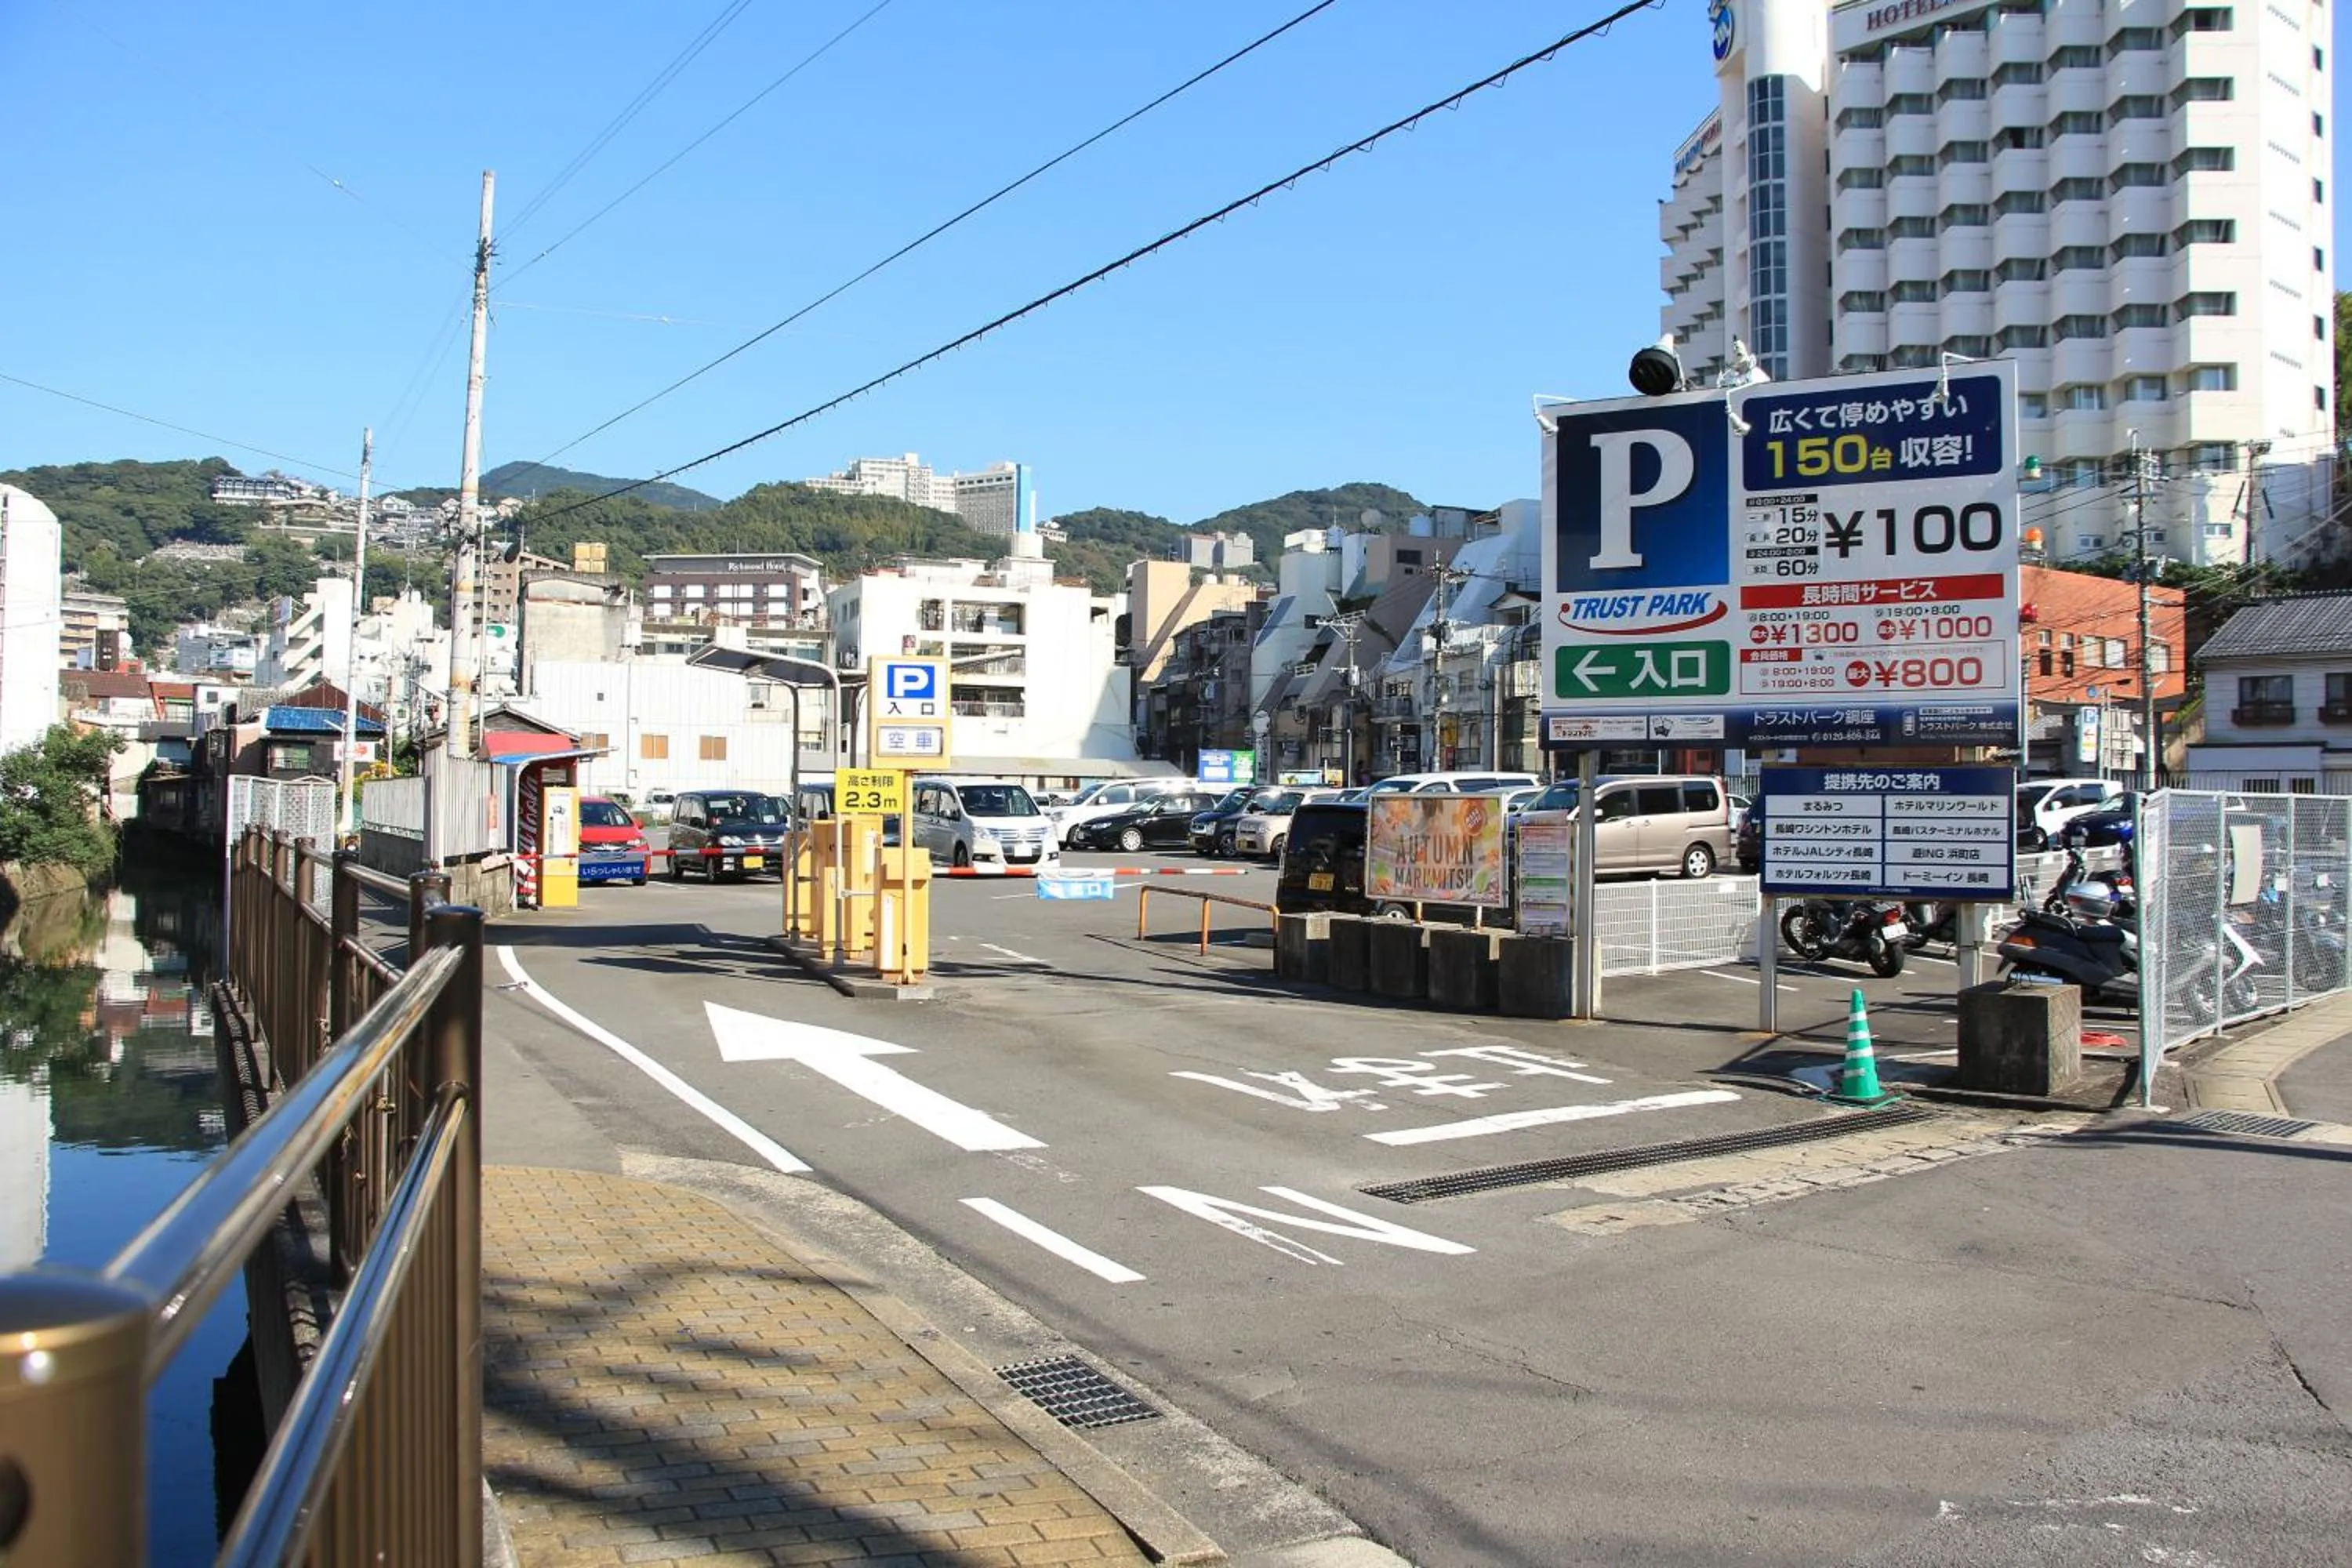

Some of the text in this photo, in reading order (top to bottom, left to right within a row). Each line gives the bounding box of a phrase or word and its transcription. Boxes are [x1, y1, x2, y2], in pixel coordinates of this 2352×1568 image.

[1769, 395, 1969, 434] 広くて停めやすい
[1766, 434, 1973, 478] 150台 収容!
[1590, 429, 1694, 569] P
[1779, 507, 1818, 524] 15分
[1776, 527, 1818, 544] 20分
[1822, 503, 2002, 558] ¥100
[1777, 559, 1819, 576] 60分
[1802, 581, 1937, 605] 長時間サービス
[1571, 592, 1712, 619] TRUST PARK
[1771, 622, 1859, 644] ¥1300
[1900, 615, 1993, 640] ¥1000
[1628, 649, 1707, 689] 入口
[1875, 657, 1983, 688] ¥800
[893, 667, 929, 697] P
[887, 702, 935, 716] 入口
[888, 731, 932, 750] 空車
[848, 775, 895, 788] 高さ制限
[1824, 772, 1940, 790] 提携先のご案内
[844, 791, 898, 808] 2.3m
[1803, 801, 1844, 811] まるみつ
[1894, 800, 1999, 811] ホテルマリンワールド
[1395, 833, 1474, 866] AUTUMN
[1394, 866, 1475, 891] MARUMITSU
